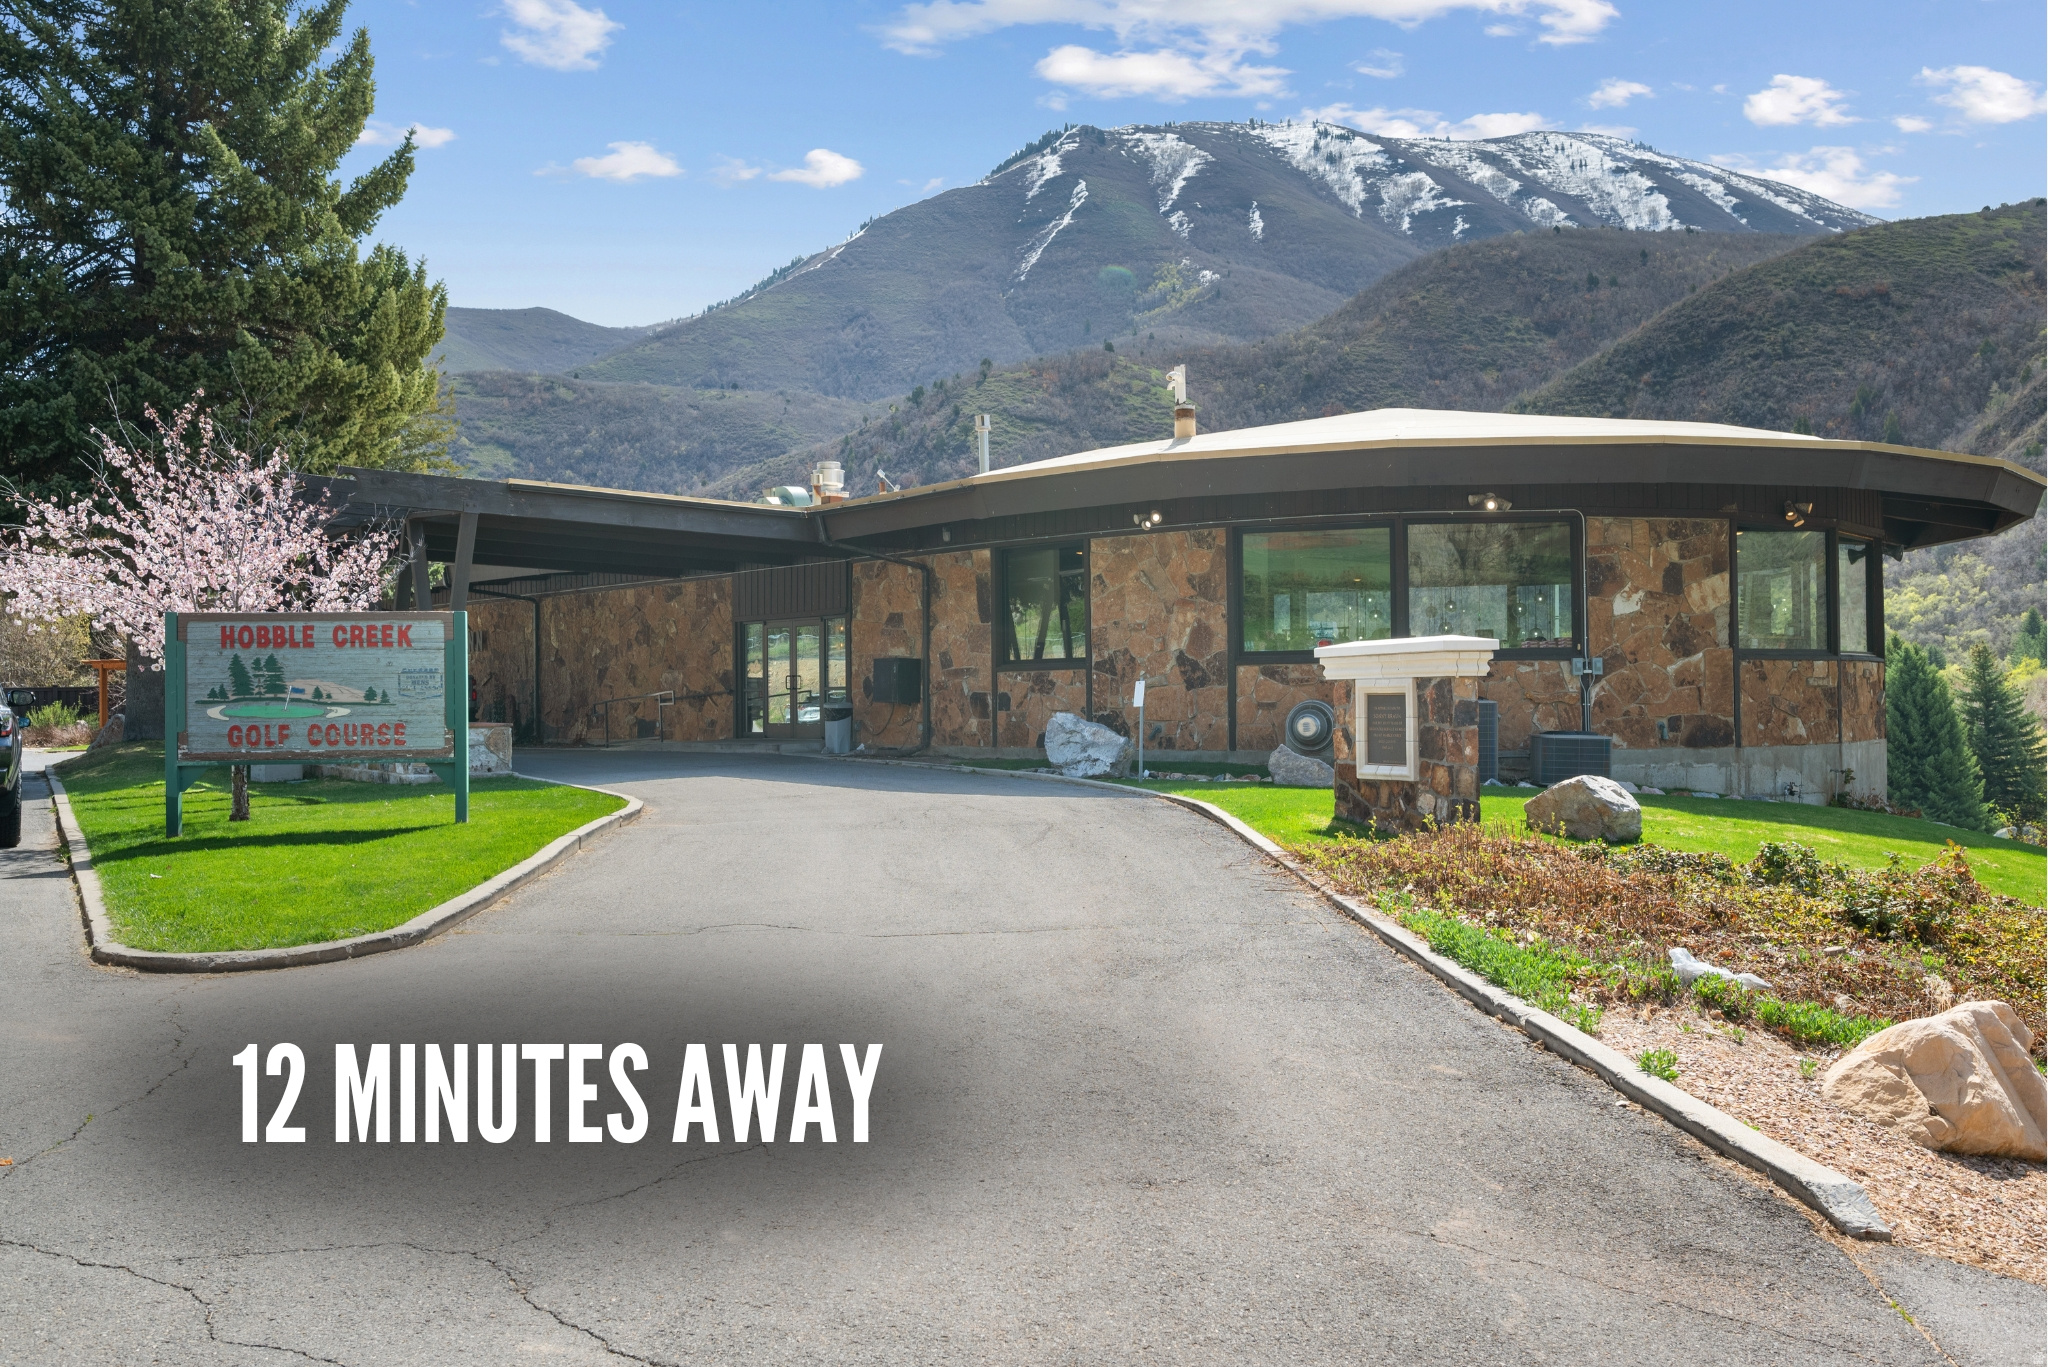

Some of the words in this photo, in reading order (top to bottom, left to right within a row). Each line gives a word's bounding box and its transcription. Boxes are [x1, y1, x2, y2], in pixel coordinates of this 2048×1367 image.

[220, 625, 315, 649] HOBBLE
[332, 624, 413, 648] CREEK
[227, 724, 290, 748] GOLF
[307, 723, 407, 747] COURSE
